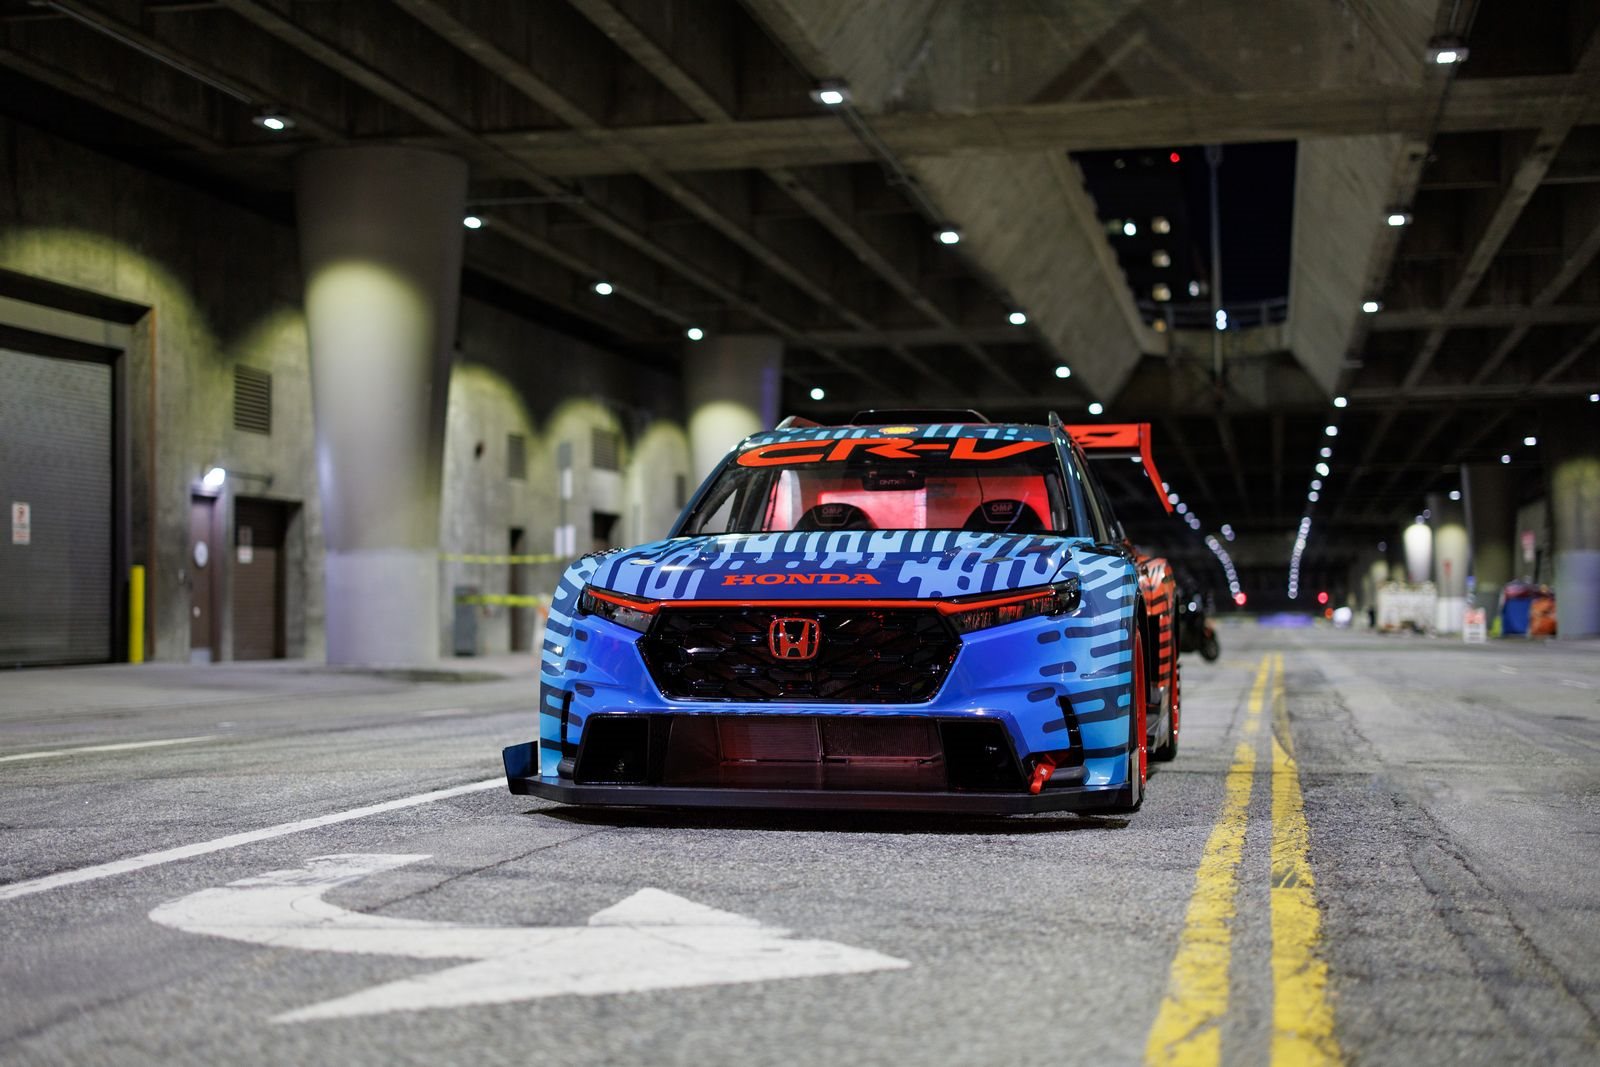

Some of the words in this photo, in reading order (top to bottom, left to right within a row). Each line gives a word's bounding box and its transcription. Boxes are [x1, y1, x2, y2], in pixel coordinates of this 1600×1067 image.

[736, 437, 1054, 467] CR-V
[992, 504, 1013, 512] OMP
[720, 573, 882, 586] HONDA
